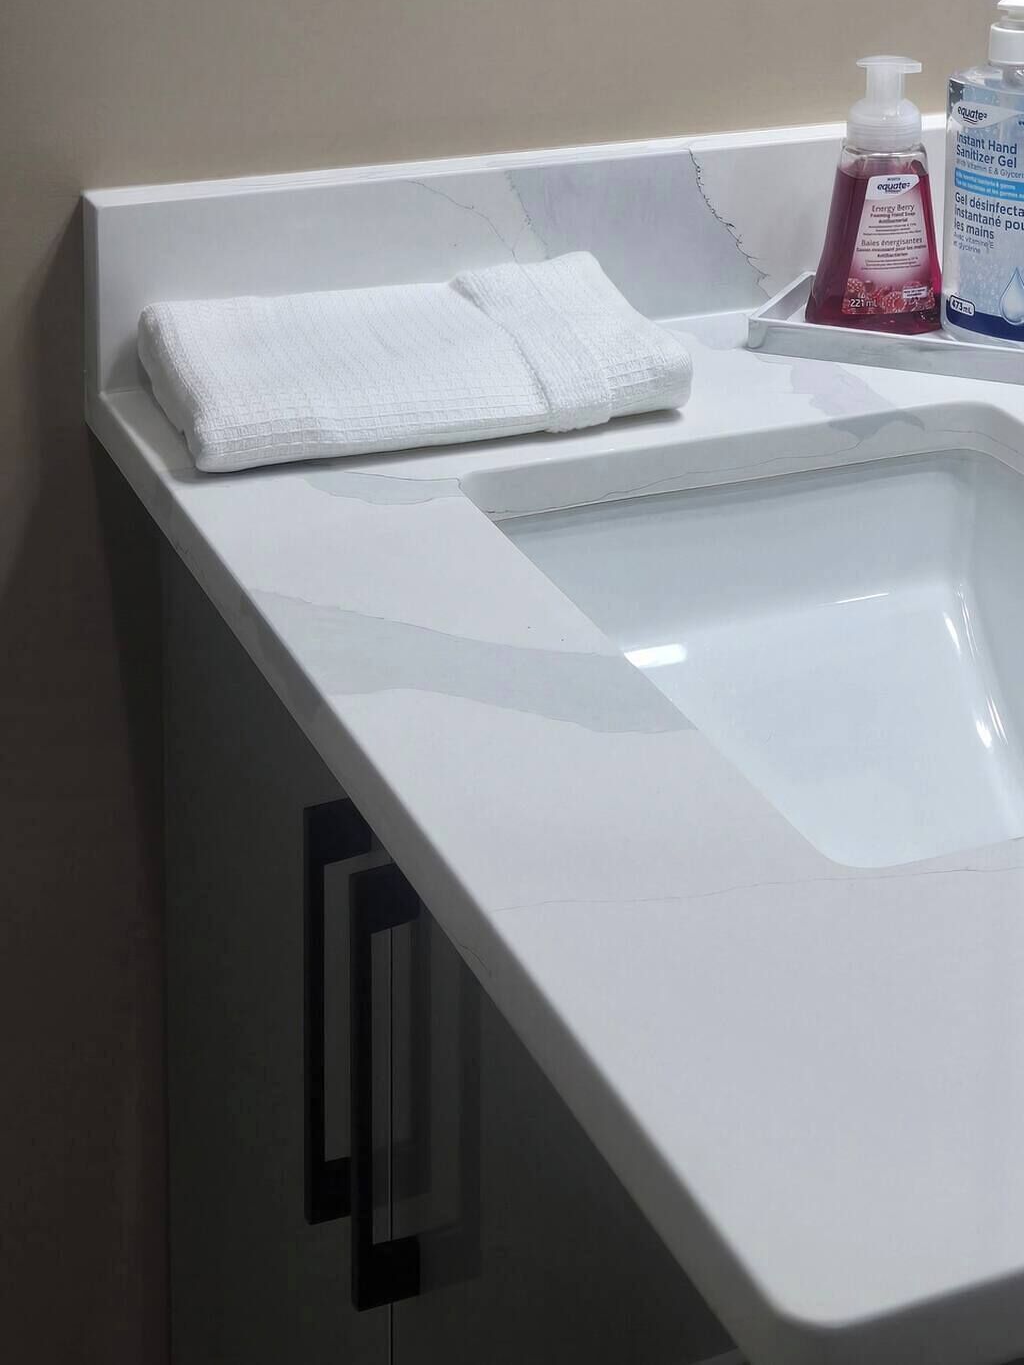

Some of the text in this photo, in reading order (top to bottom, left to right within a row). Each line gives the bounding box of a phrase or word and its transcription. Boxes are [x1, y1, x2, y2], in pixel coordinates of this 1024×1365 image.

[956, 130, 1017, 155] Instant Hand
[956, 144, 995, 165] Sanitizer
[998, 155, 1017, 168] Gel
[955, 191, 968, 205] Gel
[954, 206, 1001, 228] instantané
[954, 218, 964, 231] les
[965, 223, 995, 240] mains
